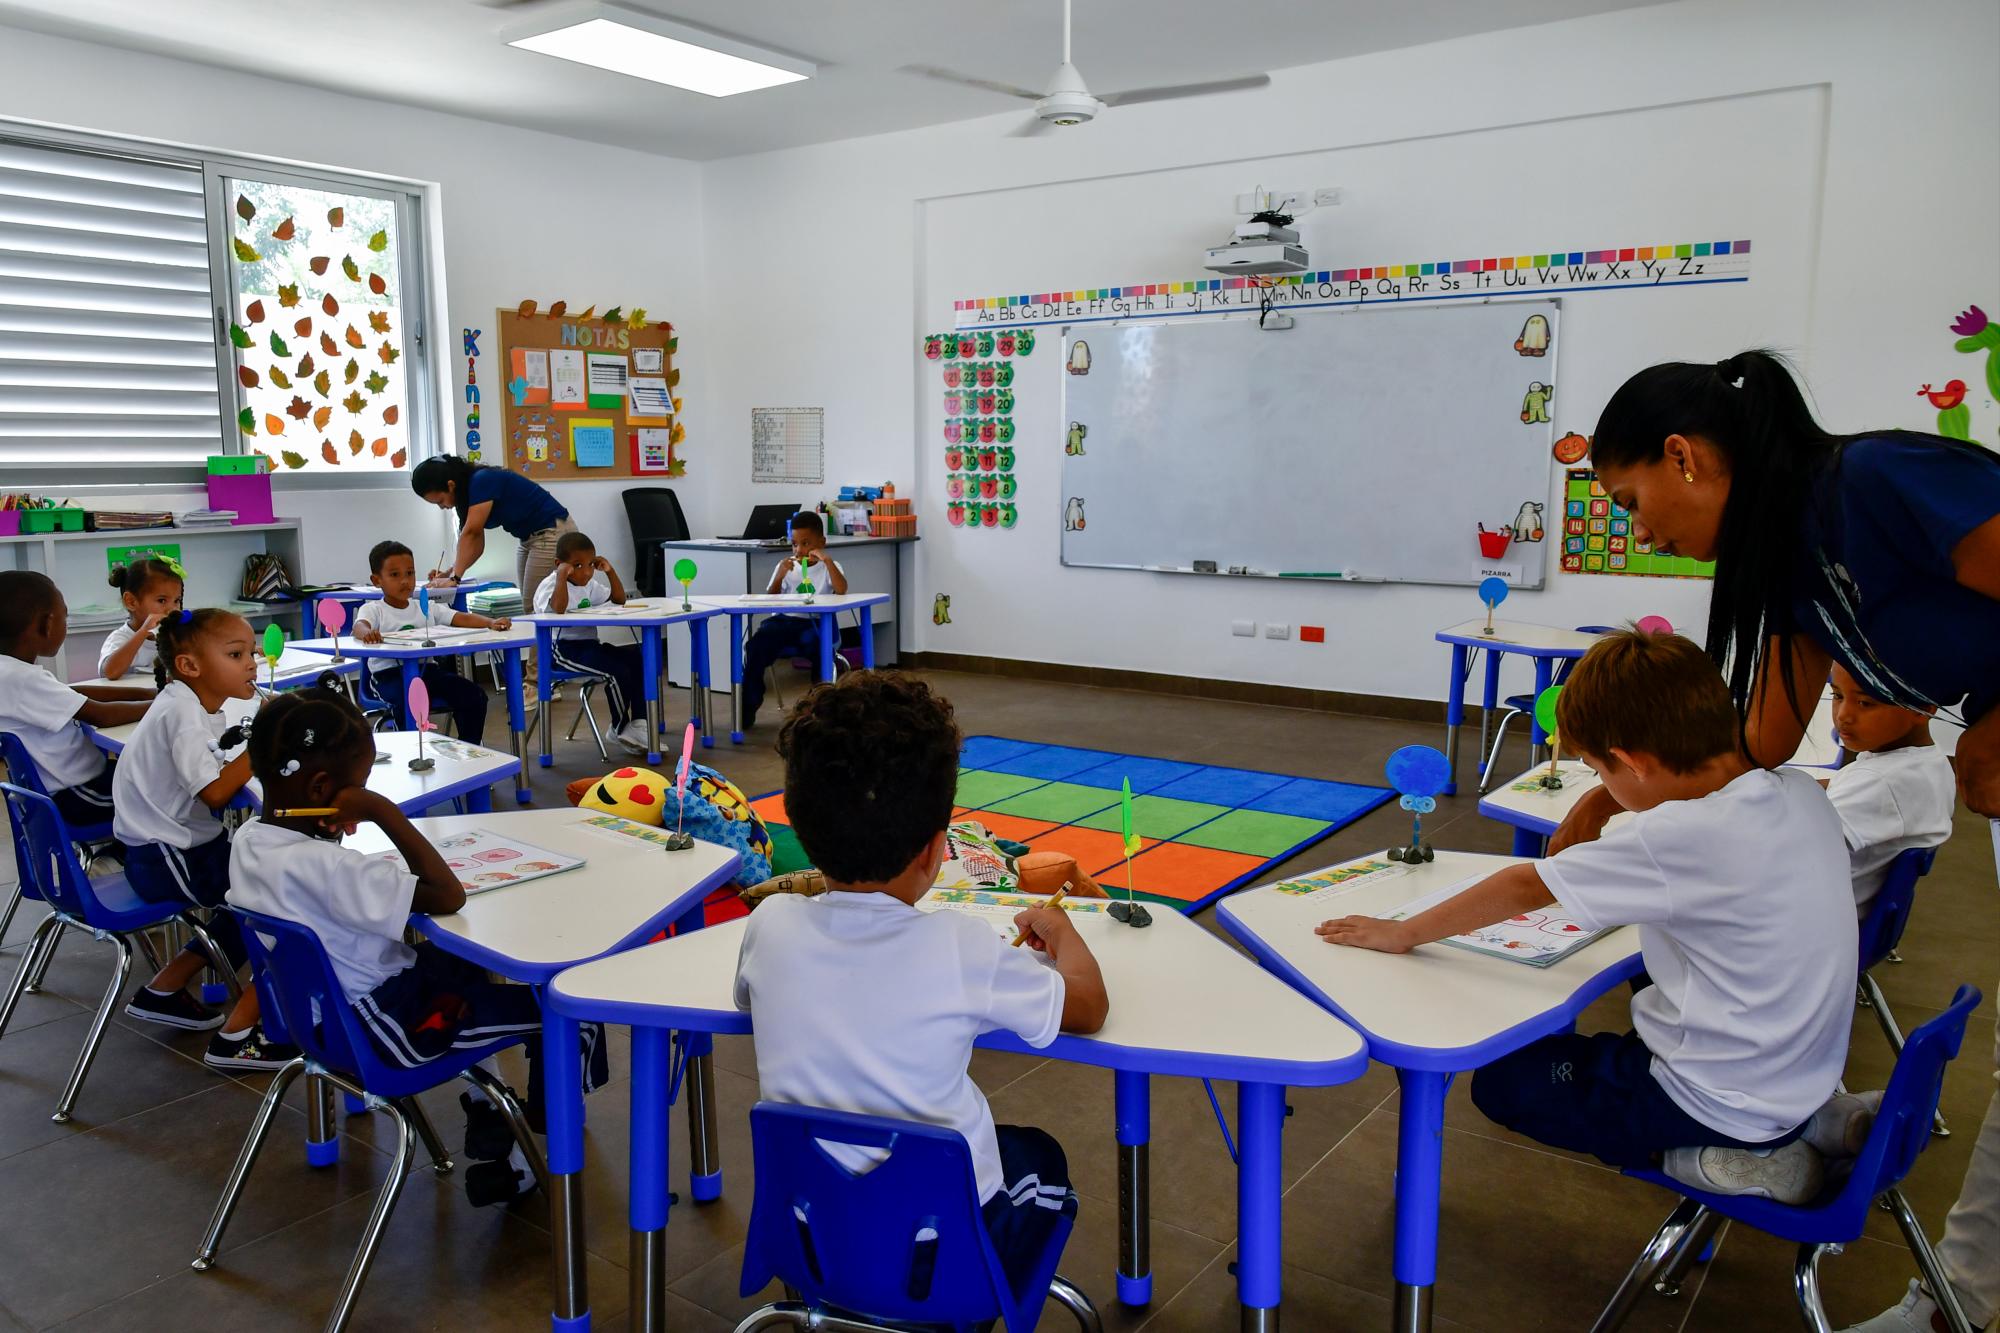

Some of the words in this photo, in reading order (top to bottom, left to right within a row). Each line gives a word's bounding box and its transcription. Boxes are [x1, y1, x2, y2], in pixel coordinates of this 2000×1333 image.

[979, 308, 994, 322] Aa
[1000, 306, 1015, 320] Bb
[1022, 304, 1037, 319] Cc
[1044, 302, 1060, 317] Dd
[1067, 301, 1081, 315] Ee
[1090, 299, 1104, 314] Ff
[1112, 297, 1130, 317] Gg
[1137, 296, 1154, 310] Hh
[1187, 293, 1202, 312] Jj
[1212, 291, 1229, 305] Kk
[1292, 285, 1312, 300] Nn
[1319, 283, 1340, 298] Oo
[1350, 281, 1368, 303] Pp
[1377, 279, 1400, 301] Qq
[1409, 277, 1428, 292] Rr
[1440, 275, 1460, 290] Ss
[1473, 272, 1491, 288] Tt
[1504, 270, 1526, 286] Uu
[1538, 268, 1559, 284] Vv
[1568, 265, 1598, 282] Ww
[1605, 263, 1630, 280] Xx
[1642, 261, 1666, 284] Yy
[1679, 258, 1703, 276] Zz
[561, 323, 630, 350] NOTAS
[928, 344, 939, 354] 25
[944, 344, 956, 354] 26
[962, 344, 973, 353] 27
[979, 343, 990, 353] 28
[1001, 340, 1012, 351] 29
[1017, 340, 1030, 350] 30
[948, 372, 957, 383] 21
[964, 372, 975, 383] 22
[981, 372, 993, 382] 23
[997, 372, 1009, 382] 24
[949, 400, 957, 410] 17
[966, 400, 975, 410] 18
[983, 399, 992, 409] 19
[998, 399, 1010, 409] 20
[949, 427, 957, 437] 13
[966, 428, 975, 438] 14
[983, 427, 992, 438] 15
[1000, 427, 1009, 438] 16
[951, 455, 957, 465] 9
[966, 456, 976, 466] 10
[984, 456, 991, 466] 11
[1000, 457, 1009, 466] 12
[952, 483, 958, 493] 5
[969, 483, 975, 494] 6
[986, 483, 993, 494] 7
[1003, 484, 1009, 494] 8
[1572, 504, 1578, 514] 7
[1595, 503, 1603, 513] 8
[954, 511, 958, 521] 1
[971, 512, 976, 521] 2
[987, 512, 993, 522] 3
[1003, 512, 1010, 522] 4
[1571, 521, 1582, 532] 14
[1593, 521, 1604, 531] 15
[1614, 522, 1625, 532] 16
[1569, 539, 1580, 549] 21
[1611, 539, 1624, 549] 23
[1565, 557, 1579, 568] 28
[1610, 556, 1624, 566] 30
[1481, 570, 1511, 587] PIZARRA
